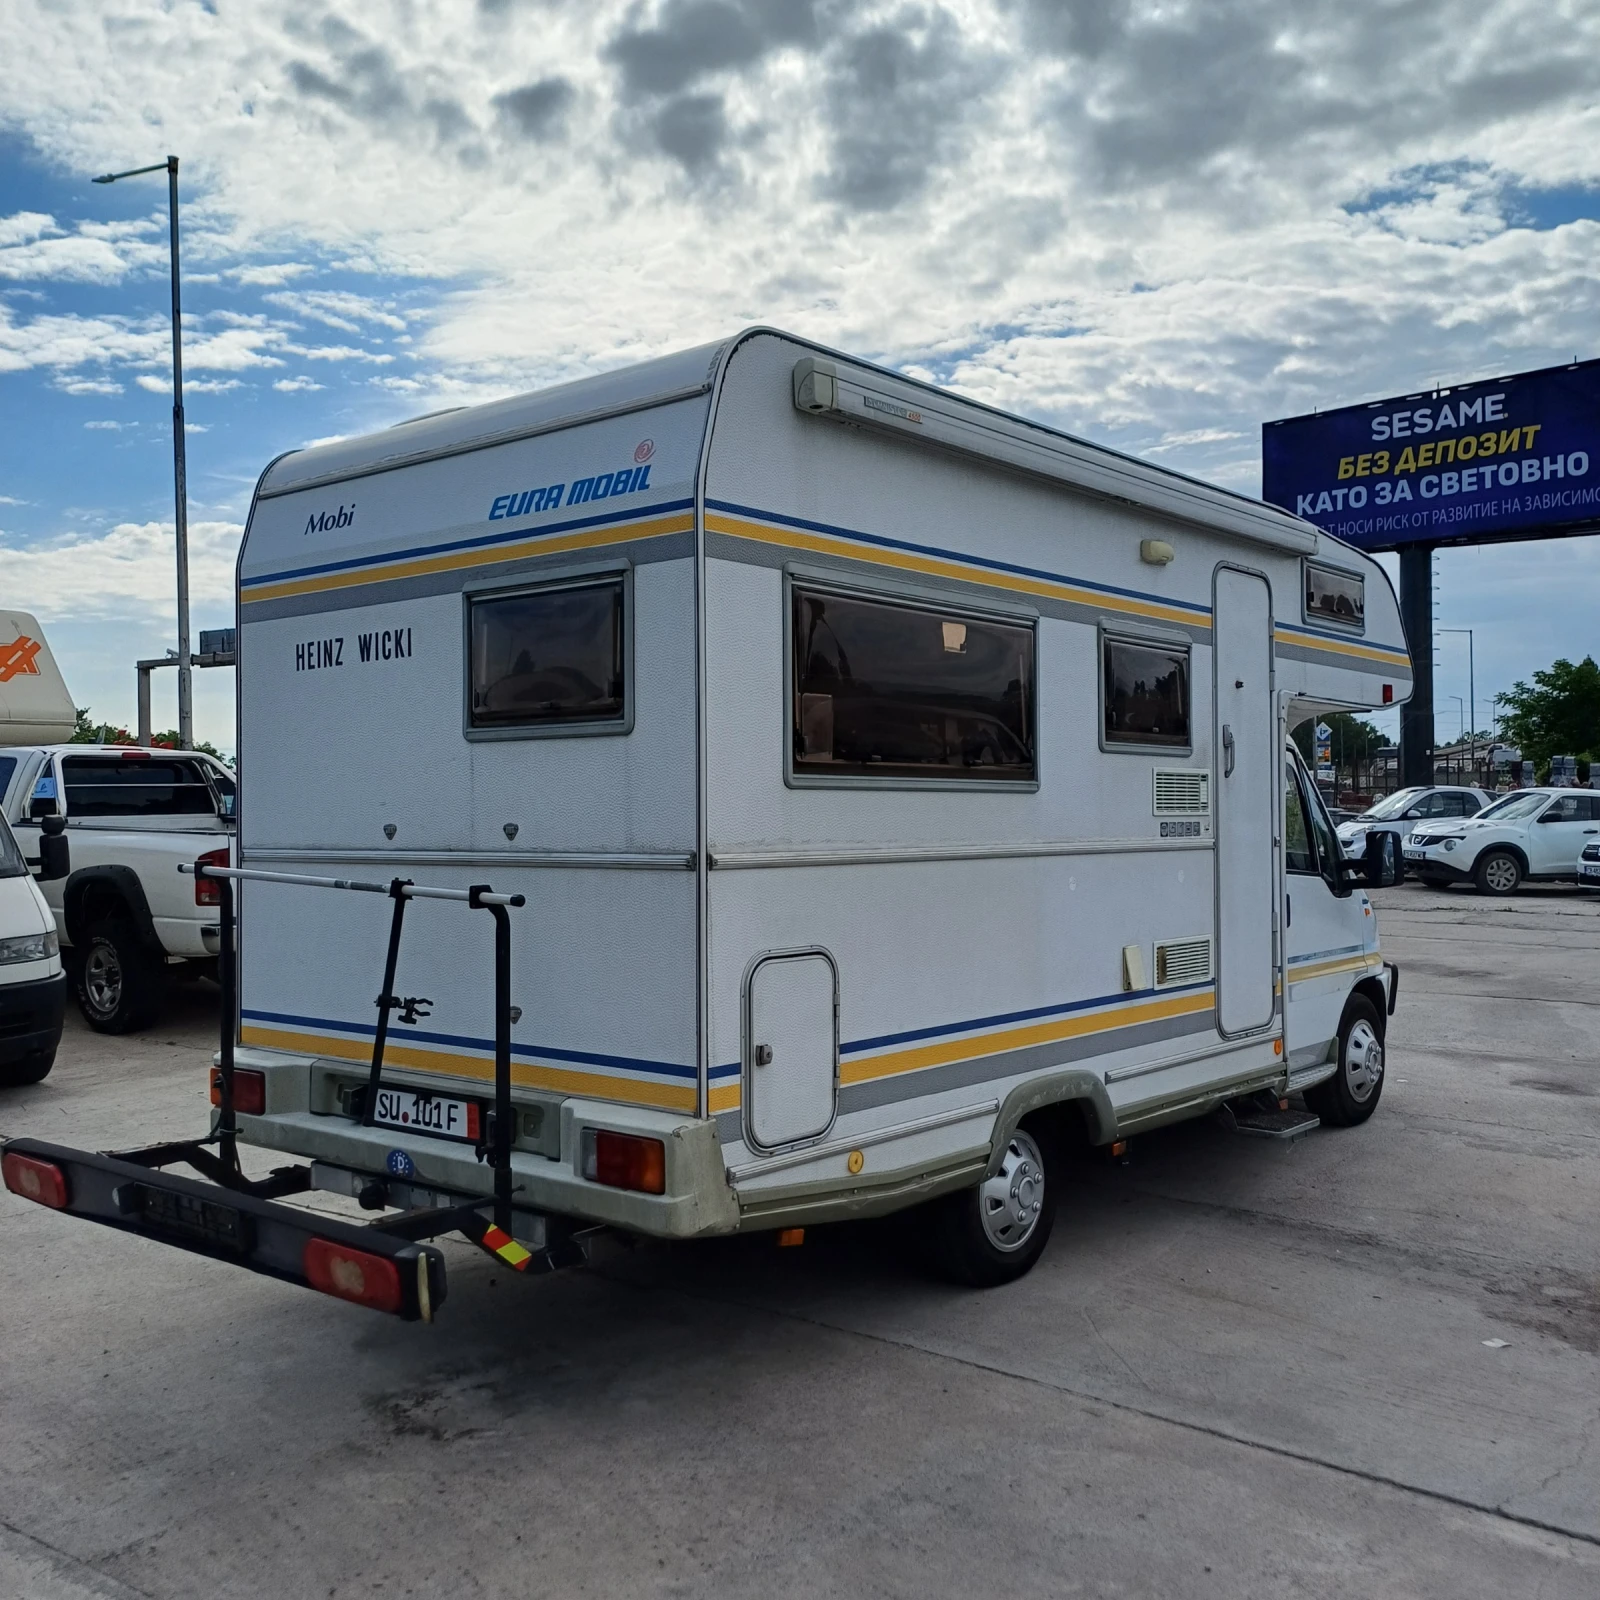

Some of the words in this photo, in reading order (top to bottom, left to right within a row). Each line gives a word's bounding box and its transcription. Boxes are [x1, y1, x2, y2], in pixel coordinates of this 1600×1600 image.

[1337, 450, 1389, 480] БЕЗ
[1394, 424, 1541, 475] ДЕПОЗИТ
[488, 483, 566, 520] EURA
[566, 464, 652, 507] MOBIL
[1296, 485, 1368, 516] КАТО
[1374, 480, 1413, 504] ЗА
[1419, 451, 1590, 498] СВЕТОВНО
[304, 503, 356, 536] Mobi
[1337, 518, 1373, 537] НОСИ
[1376, 513, 1409, 532] РИСК
[1411, 510, 1430, 527] ОТ
[1432, 500, 1499, 524] РАЗВИТИЕ
[1501, 497, 1522, 515] НА
[295, 637, 345, 672] HEINZ
[357, 627, 413, 664] WICKI
[397, 1155, 405, 1169] D
